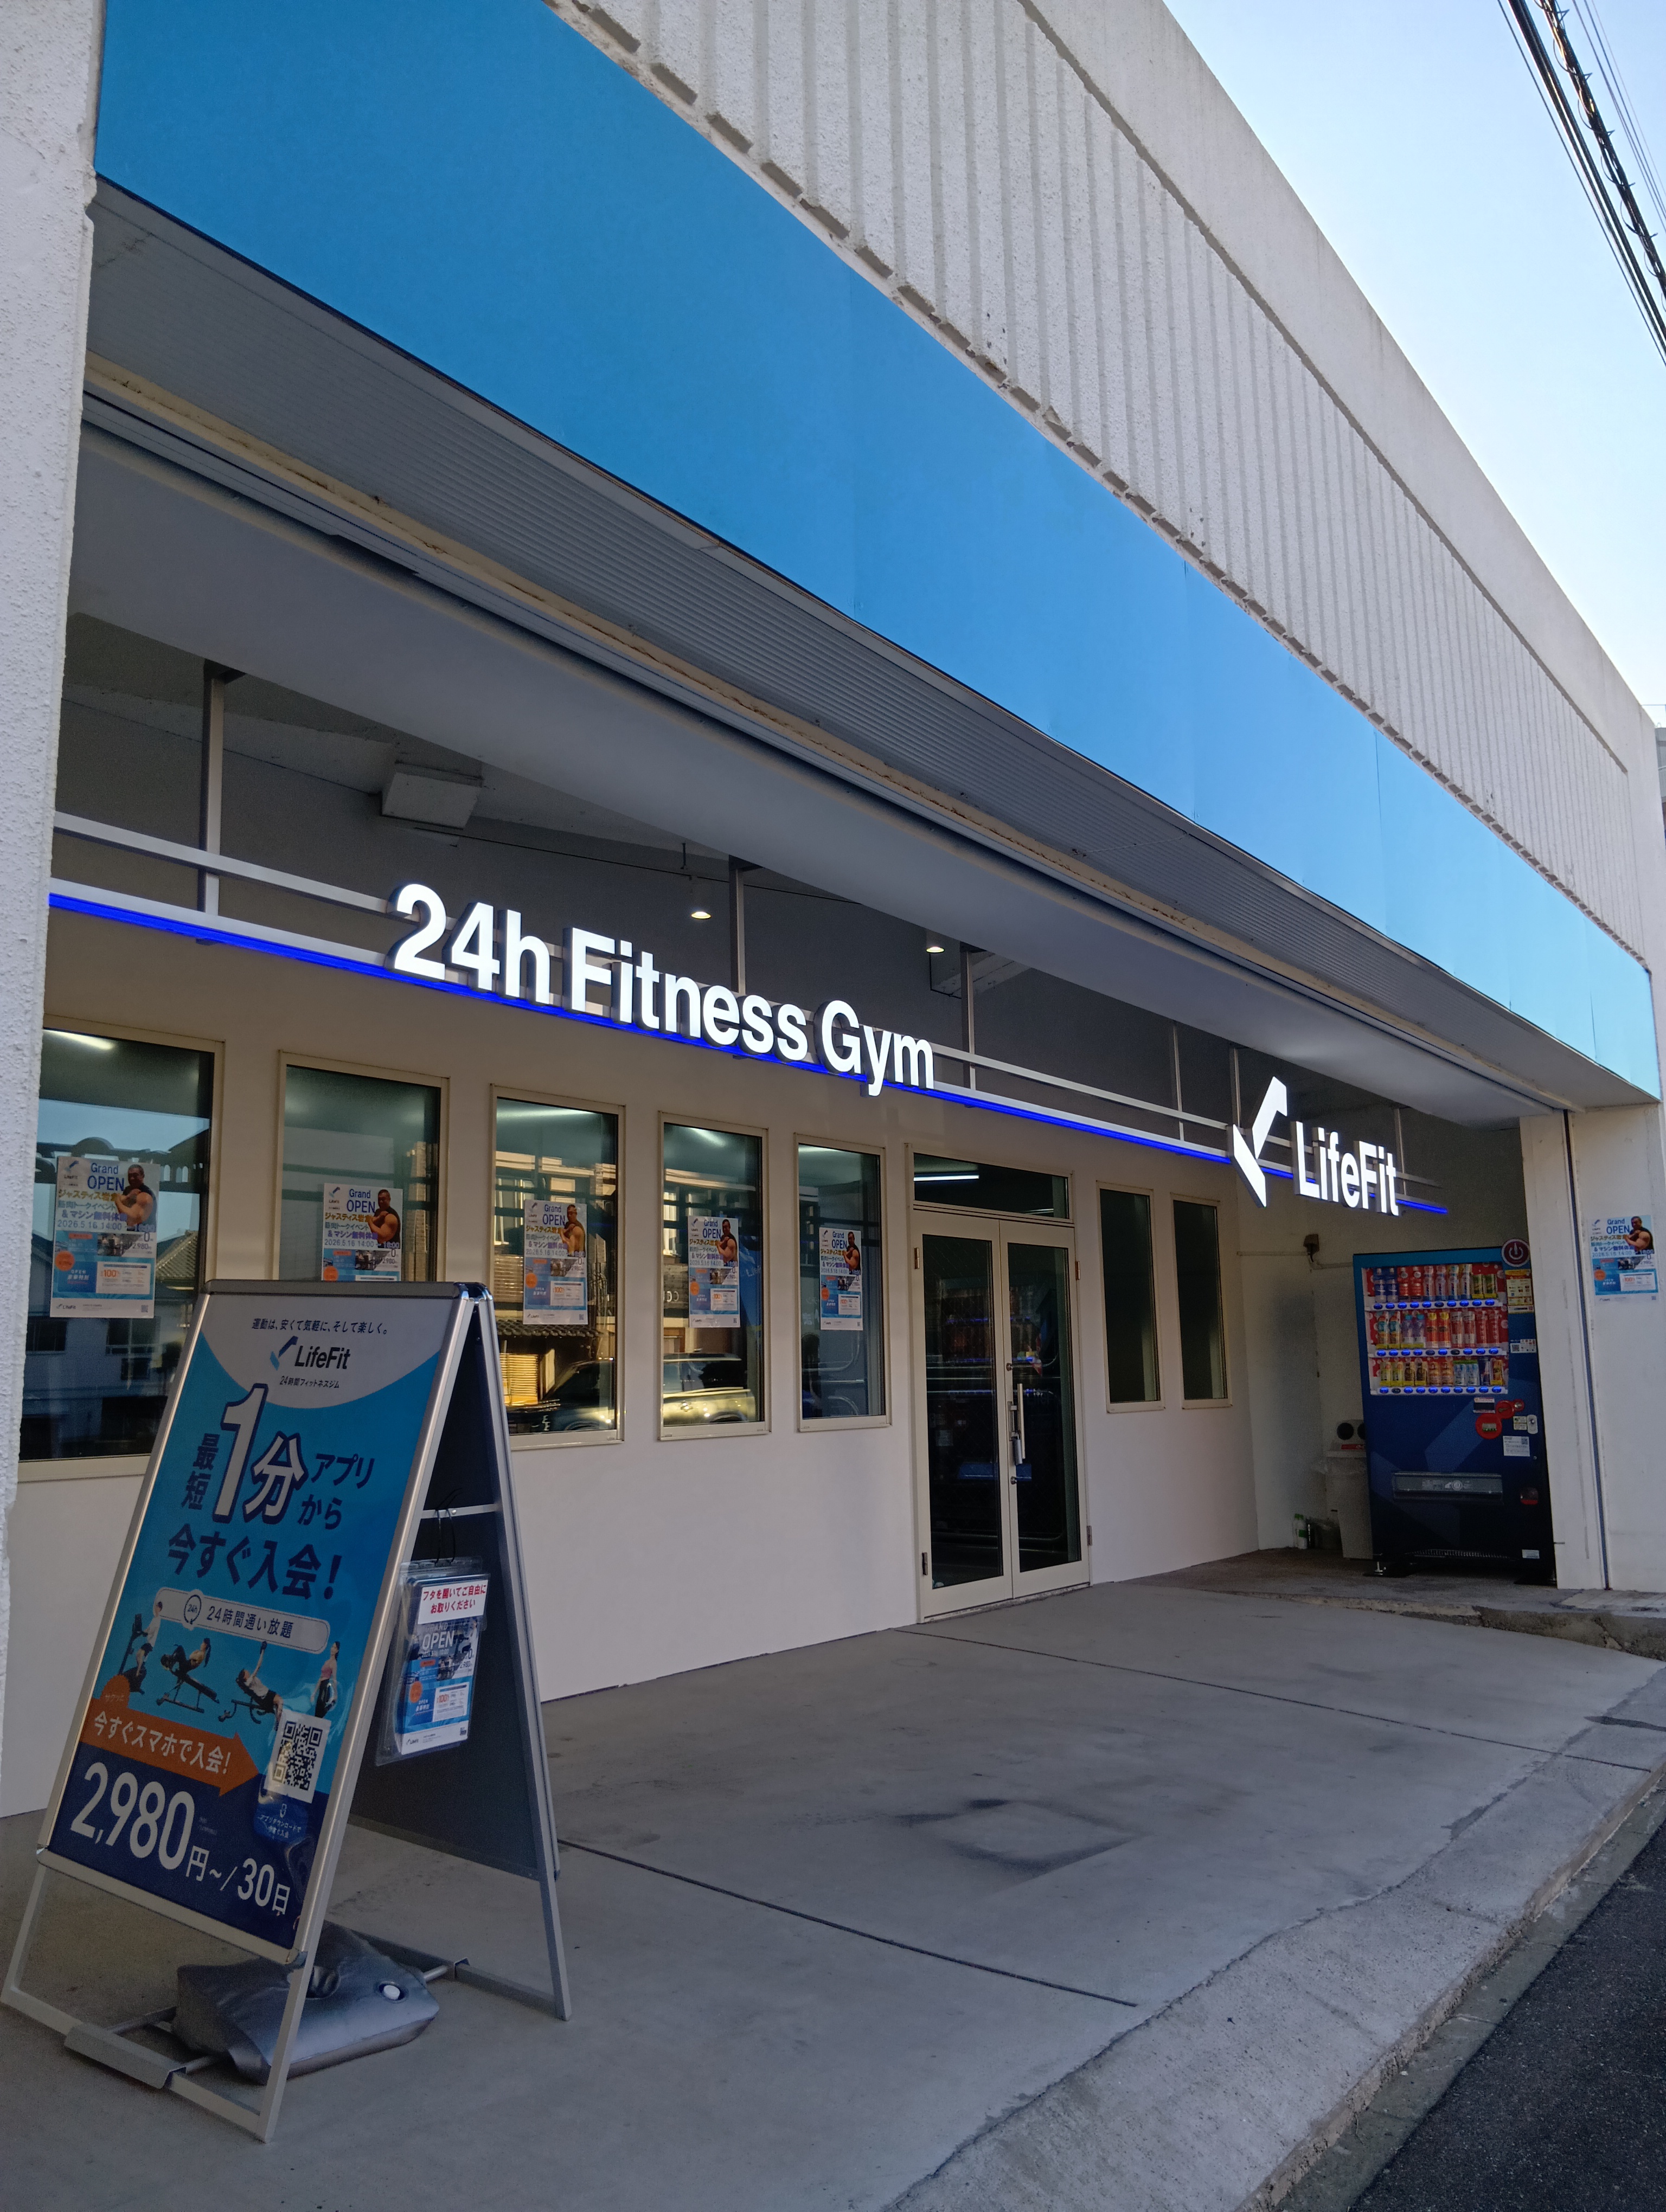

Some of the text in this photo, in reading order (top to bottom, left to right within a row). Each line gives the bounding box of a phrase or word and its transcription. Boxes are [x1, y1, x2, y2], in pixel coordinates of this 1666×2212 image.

[393, 884, 934, 1096] 24h Fitness Gym
[91, 1163, 119, 1174] Grand
[1294, 1121, 1399, 1216] LifeFit
[87, 1175, 125, 1192] OPEN
[349, 1188, 371, 1199] Grand
[346, 1199, 375, 1213] OPEN
[544, 1204, 562, 1213] Grand
[57, 1220, 98, 1229] 2026.5.16
[101, 1223, 123, 1231] 14:00
[542, 1213, 566, 1226] OPEN
[704, 1219, 718, 1227] Grand
[702, 1228, 721, 1239] OPEN
[1606, 1225, 1630, 1234] OPEN
[831, 1239, 847, 1249] OPEN
[252, 1318, 388, 1335] 運動は、安くて気軽に、そして楽しく。
[294, 1345, 351, 1369] LifeFit
[279, 1375, 340, 1388] 24時間フィットネスジム
[212, 1383, 308, 1525] 1分
[181, 1433, 221, 1510] 最短
[310, 1453, 375, 1489] アプリ
[297, 1494, 343, 1531] から
[166, 1522, 342, 1600] 今すぐ入会!
[423, 1584, 486, 1601] フタを開いてご自由に
[187, 1604, 198, 1613] 24h
[431, 1599, 476, 1614] お取りください
[207, 1606, 294, 1638] 24時間通い放題
[422, 1630, 455, 1651] OPEN
[94, 1711, 231, 1774] 今すぐスマホで入会!
